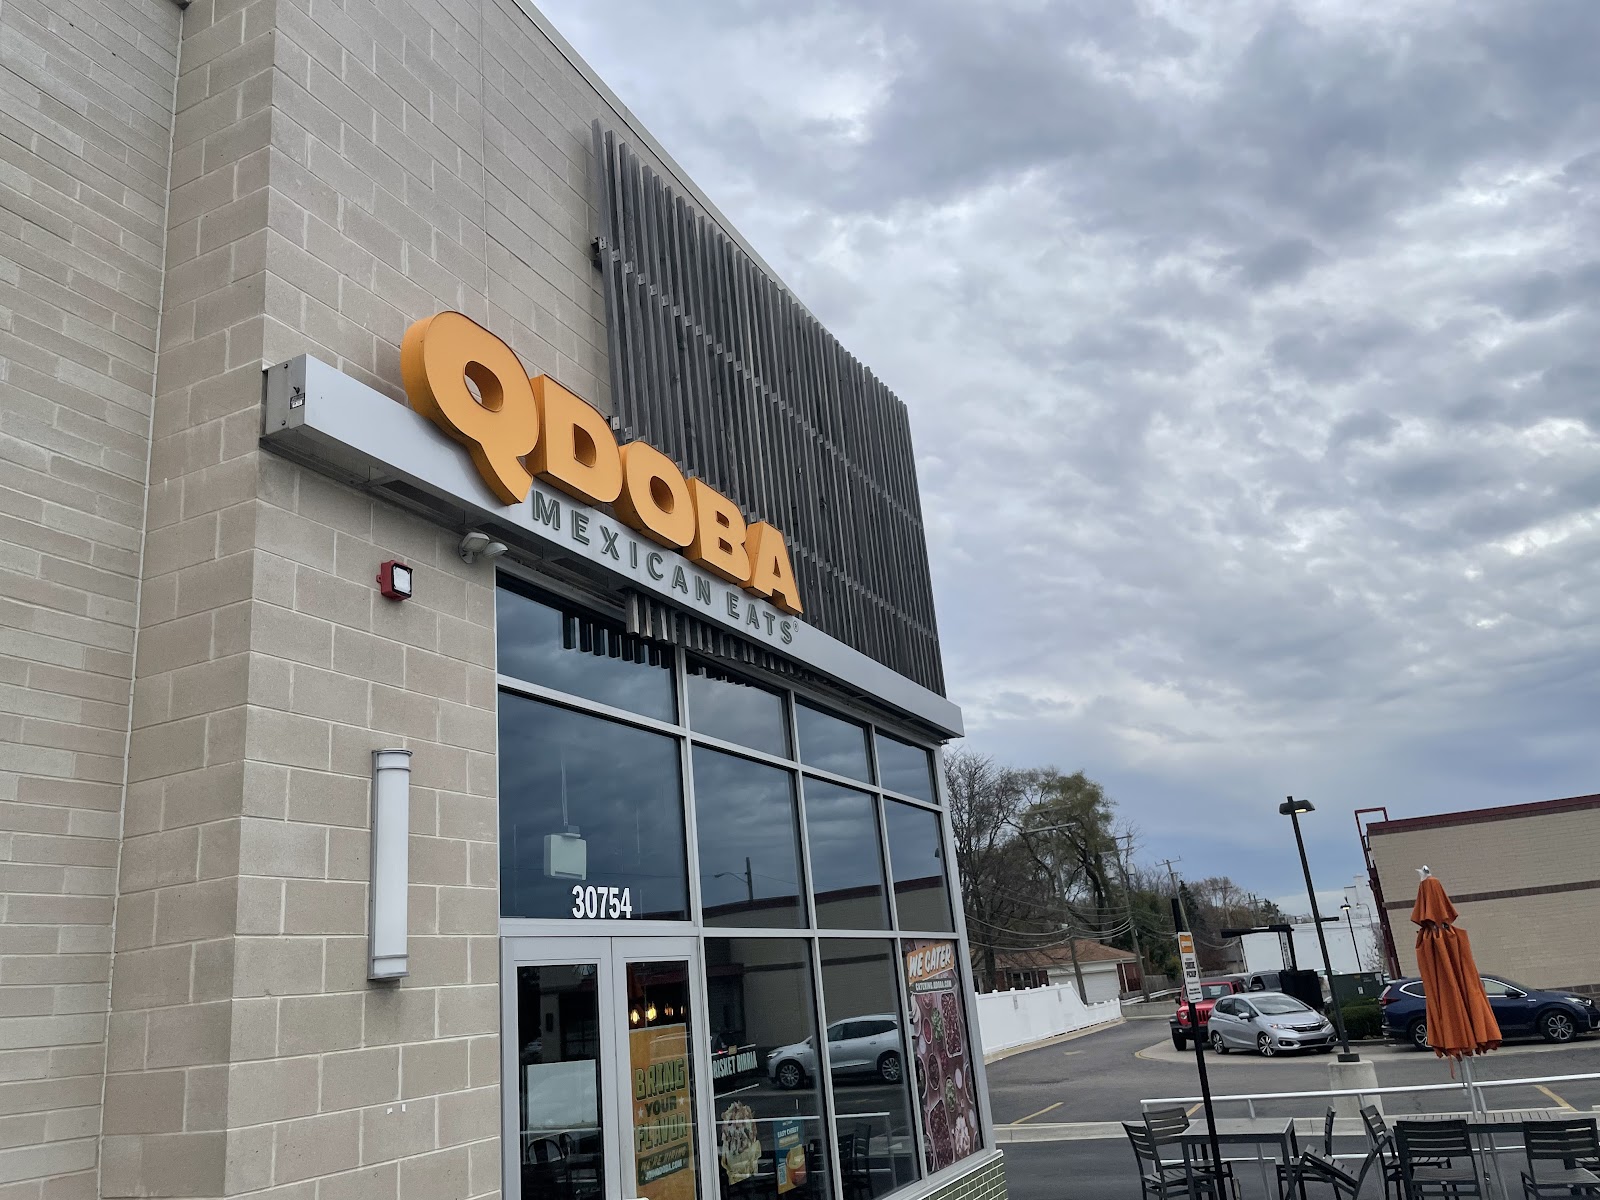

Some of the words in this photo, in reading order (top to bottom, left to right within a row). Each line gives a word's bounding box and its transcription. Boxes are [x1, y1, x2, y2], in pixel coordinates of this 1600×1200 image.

[401, 310, 803, 615] QDOBA
[532, 489, 712, 605] MEXICAN
[572, 885, 632, 919] 30754
[909, 952, 924, 978] WE
[924, 943, 951, 973] CATER
[635, 1059, 685, 1100] BRING
[712, 1055, 736, 1079] RISKET
[644, 1096, 677, 1117] YOUR
[634, 1113, 688, 1152] FLAVOR
